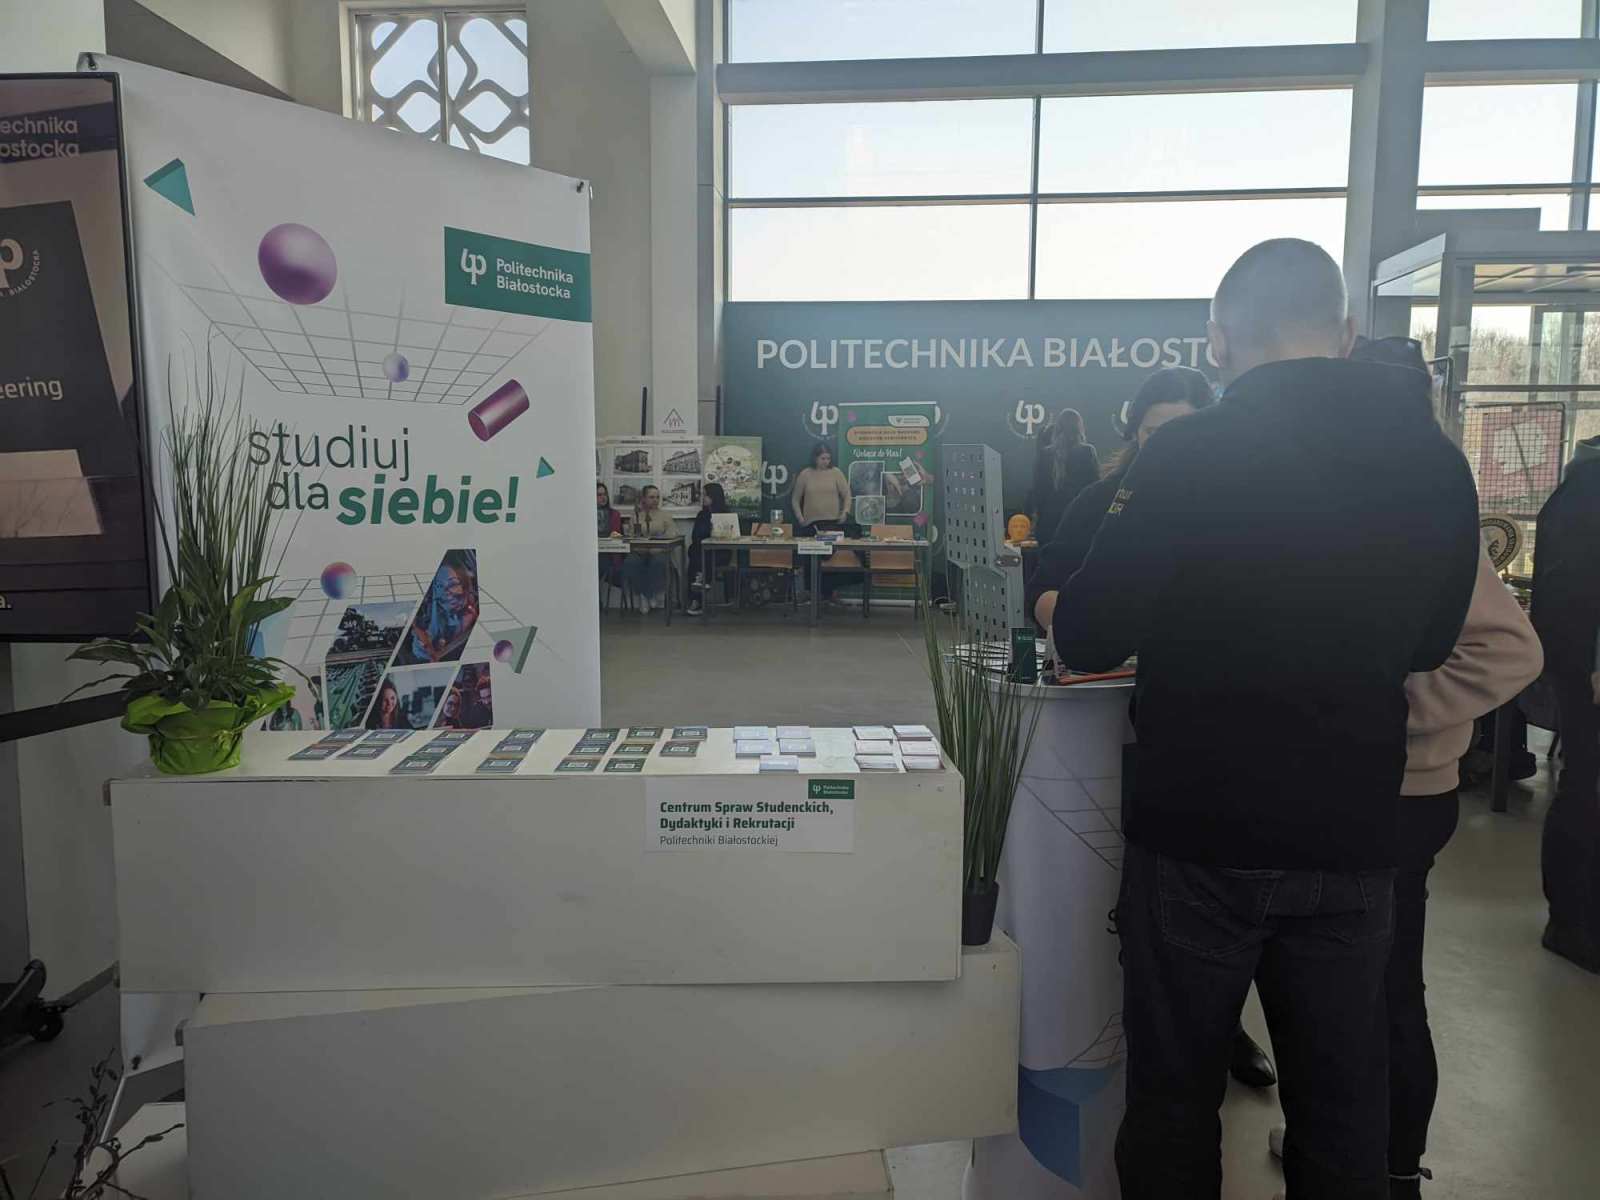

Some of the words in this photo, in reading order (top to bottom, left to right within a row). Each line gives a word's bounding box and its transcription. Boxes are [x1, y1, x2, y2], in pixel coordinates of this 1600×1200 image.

[496, 258, 574, 284] Politechnika
[496, 275, 571, 299] Białostocka
[757, 337, 1034, 370] POLITECHNIKA
[248, 422, 410, 482] studiuj
[267, 471, 329, 510] dla
[336, 473, 519, 526] siebie!
[660, 802, 712, 813] Centrum
[714, 802, 752, 815] Spraw
[756, 801, 834, 815] Studenckich,
[660, 817, 723, 832] Dydaktyki
[725, 817, 730, 829] i
[733, 817, 795, 832] Rekrutacji
[660, 835, 715, 846] Politechniki
[718, 835, 778, 847] Białostockiej
